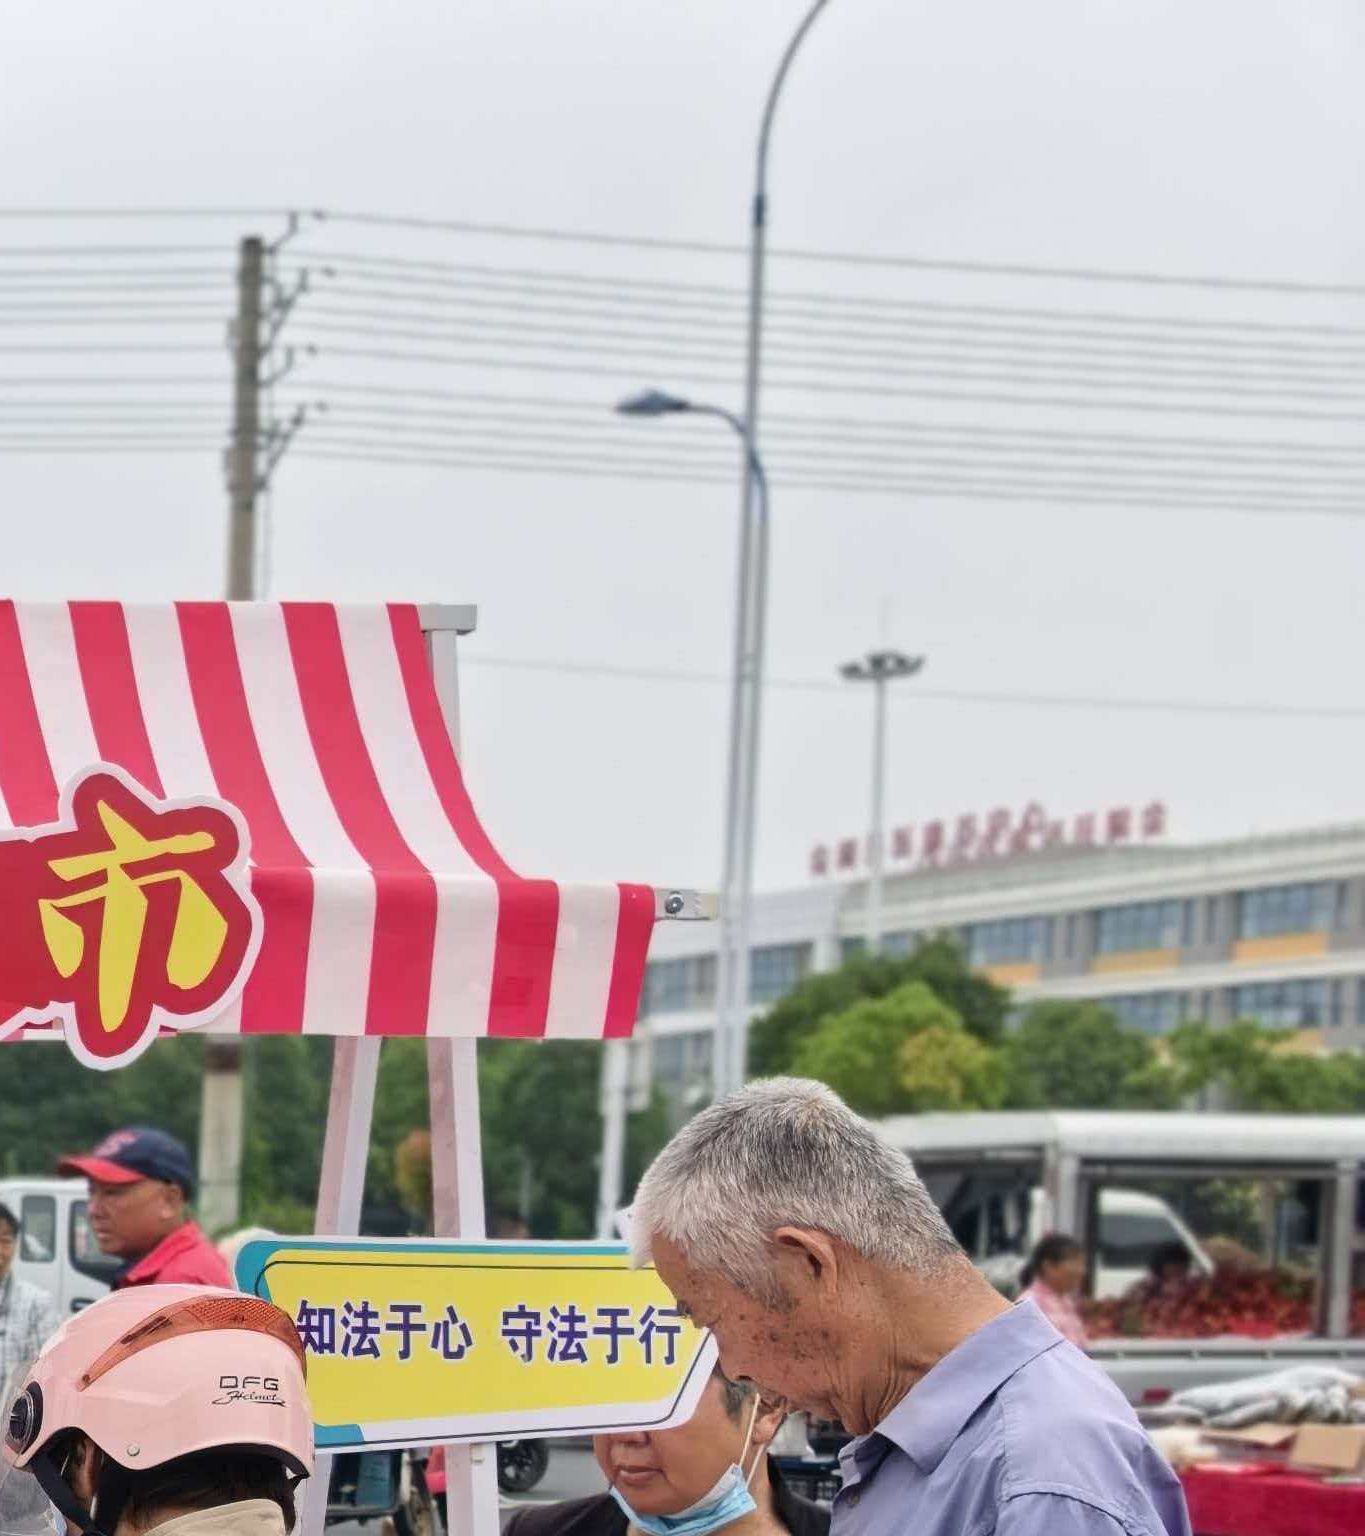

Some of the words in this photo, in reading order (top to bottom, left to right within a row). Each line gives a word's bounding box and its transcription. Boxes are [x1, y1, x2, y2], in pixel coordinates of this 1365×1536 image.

[297, 1299, 473, 1361] 知法于心
[502, 1301, 682, 1366] 守法于行
